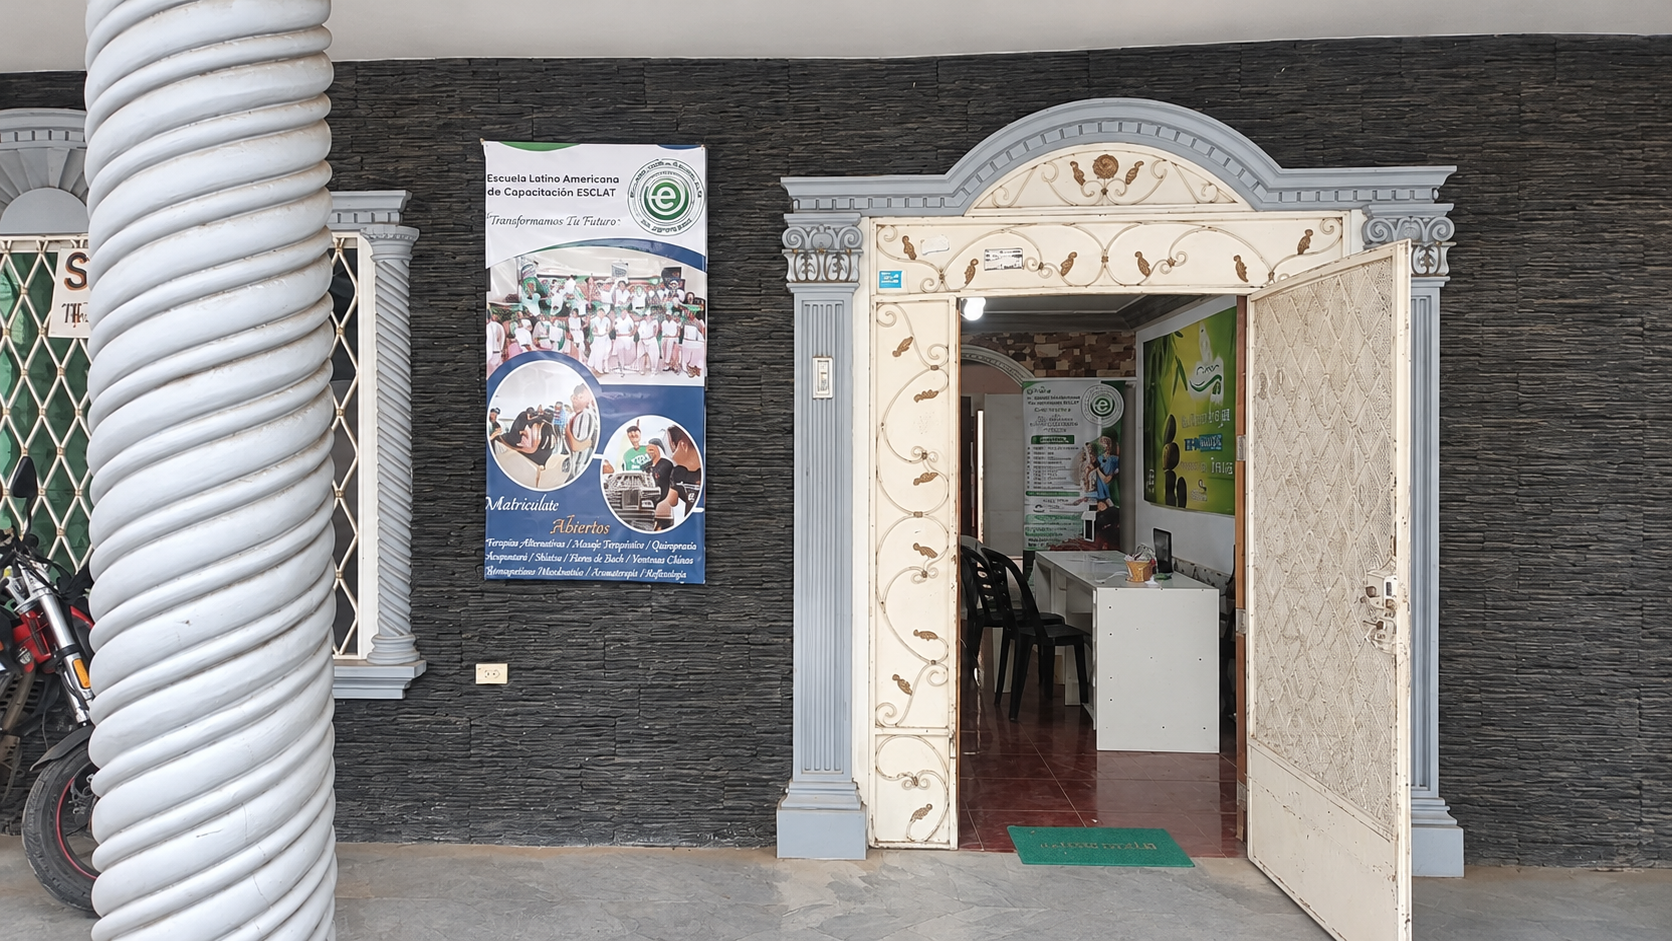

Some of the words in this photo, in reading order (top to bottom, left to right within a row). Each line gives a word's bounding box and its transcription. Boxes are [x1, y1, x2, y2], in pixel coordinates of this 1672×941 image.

[487, 174, 527, 183] Escuela
[529, 174, 561, 184] Latino
[563, 175, 620, 184] Americana
[487, 187, 502, 196] de
[504, 187, 574, 198] Capacitación
[577, 188, 617, 197] ESCLAT
[566, 216, 581, 226] Tu
[550, 514, 610, 535] Abiertos
